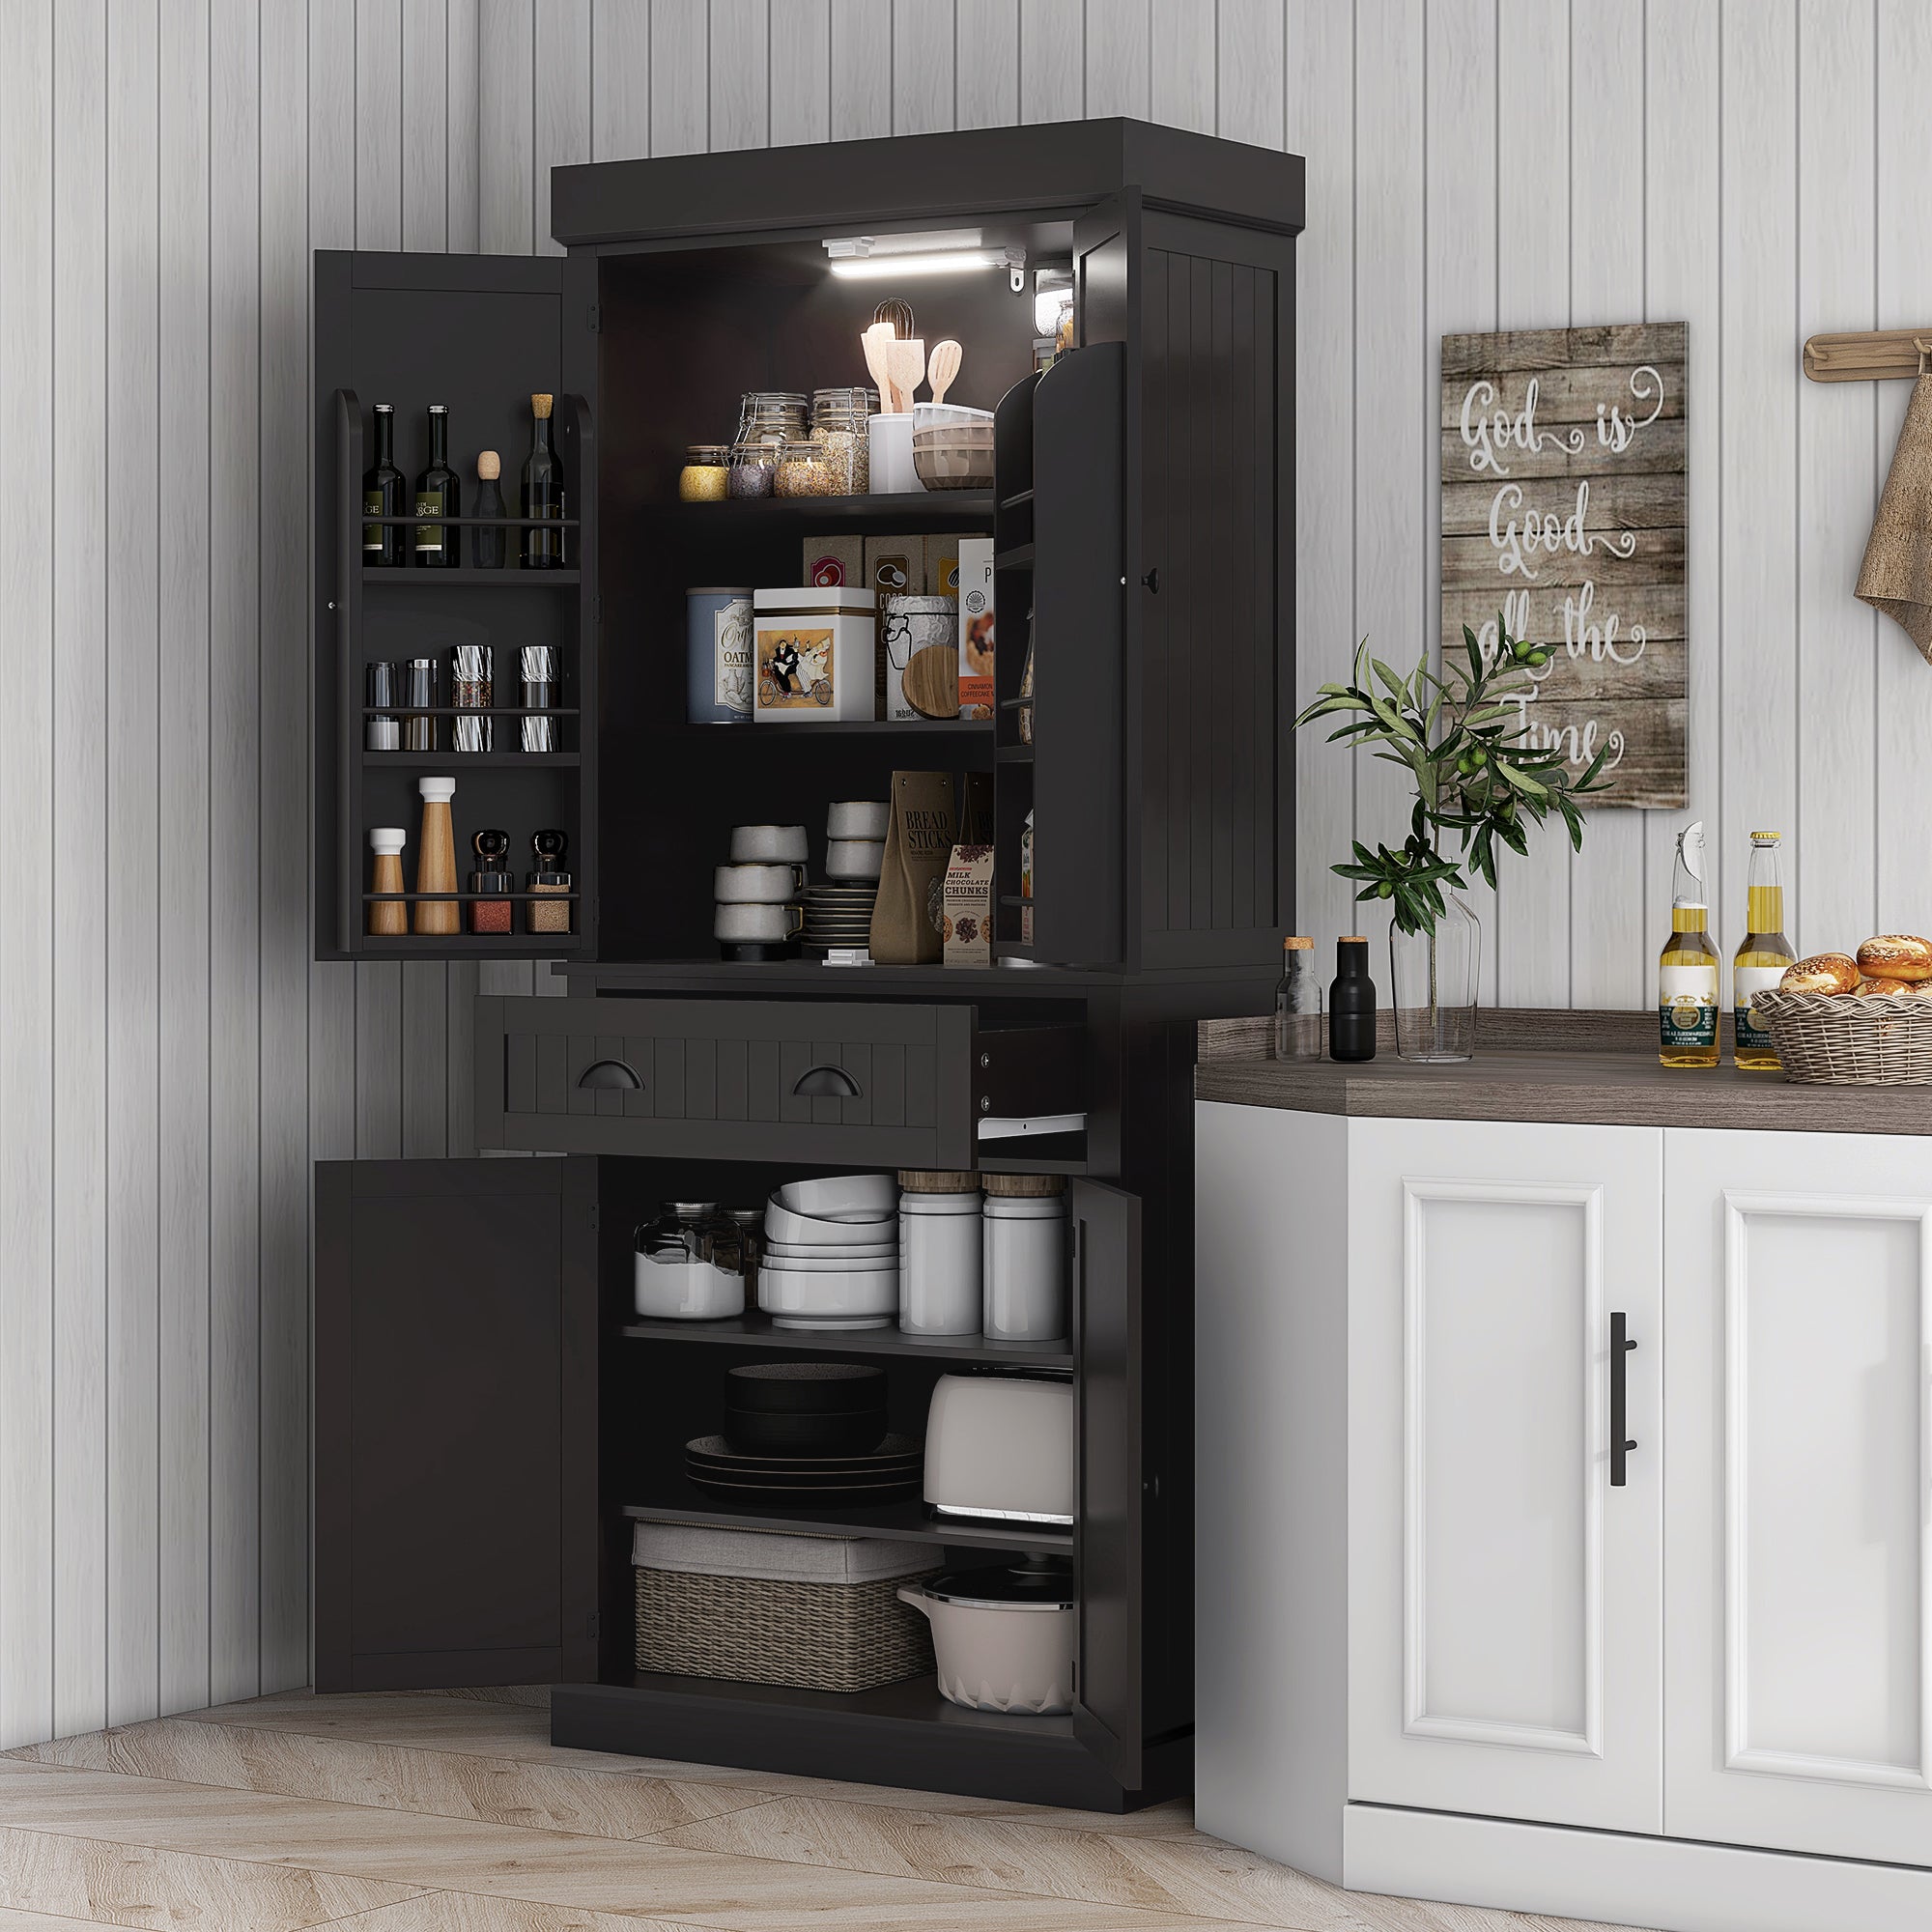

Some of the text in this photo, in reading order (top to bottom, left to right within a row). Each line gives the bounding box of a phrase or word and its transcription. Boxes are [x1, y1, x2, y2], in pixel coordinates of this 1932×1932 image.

[1460, 365, 1663, 474] God is
[1489, 480, 1635, 579] Good
[1477, 581, 1646, 681] all the
[1499, 685, 1625, 770] Time
[905, 810, 948, 829] BREAD
[908, 830, 952, 849] STICKS
